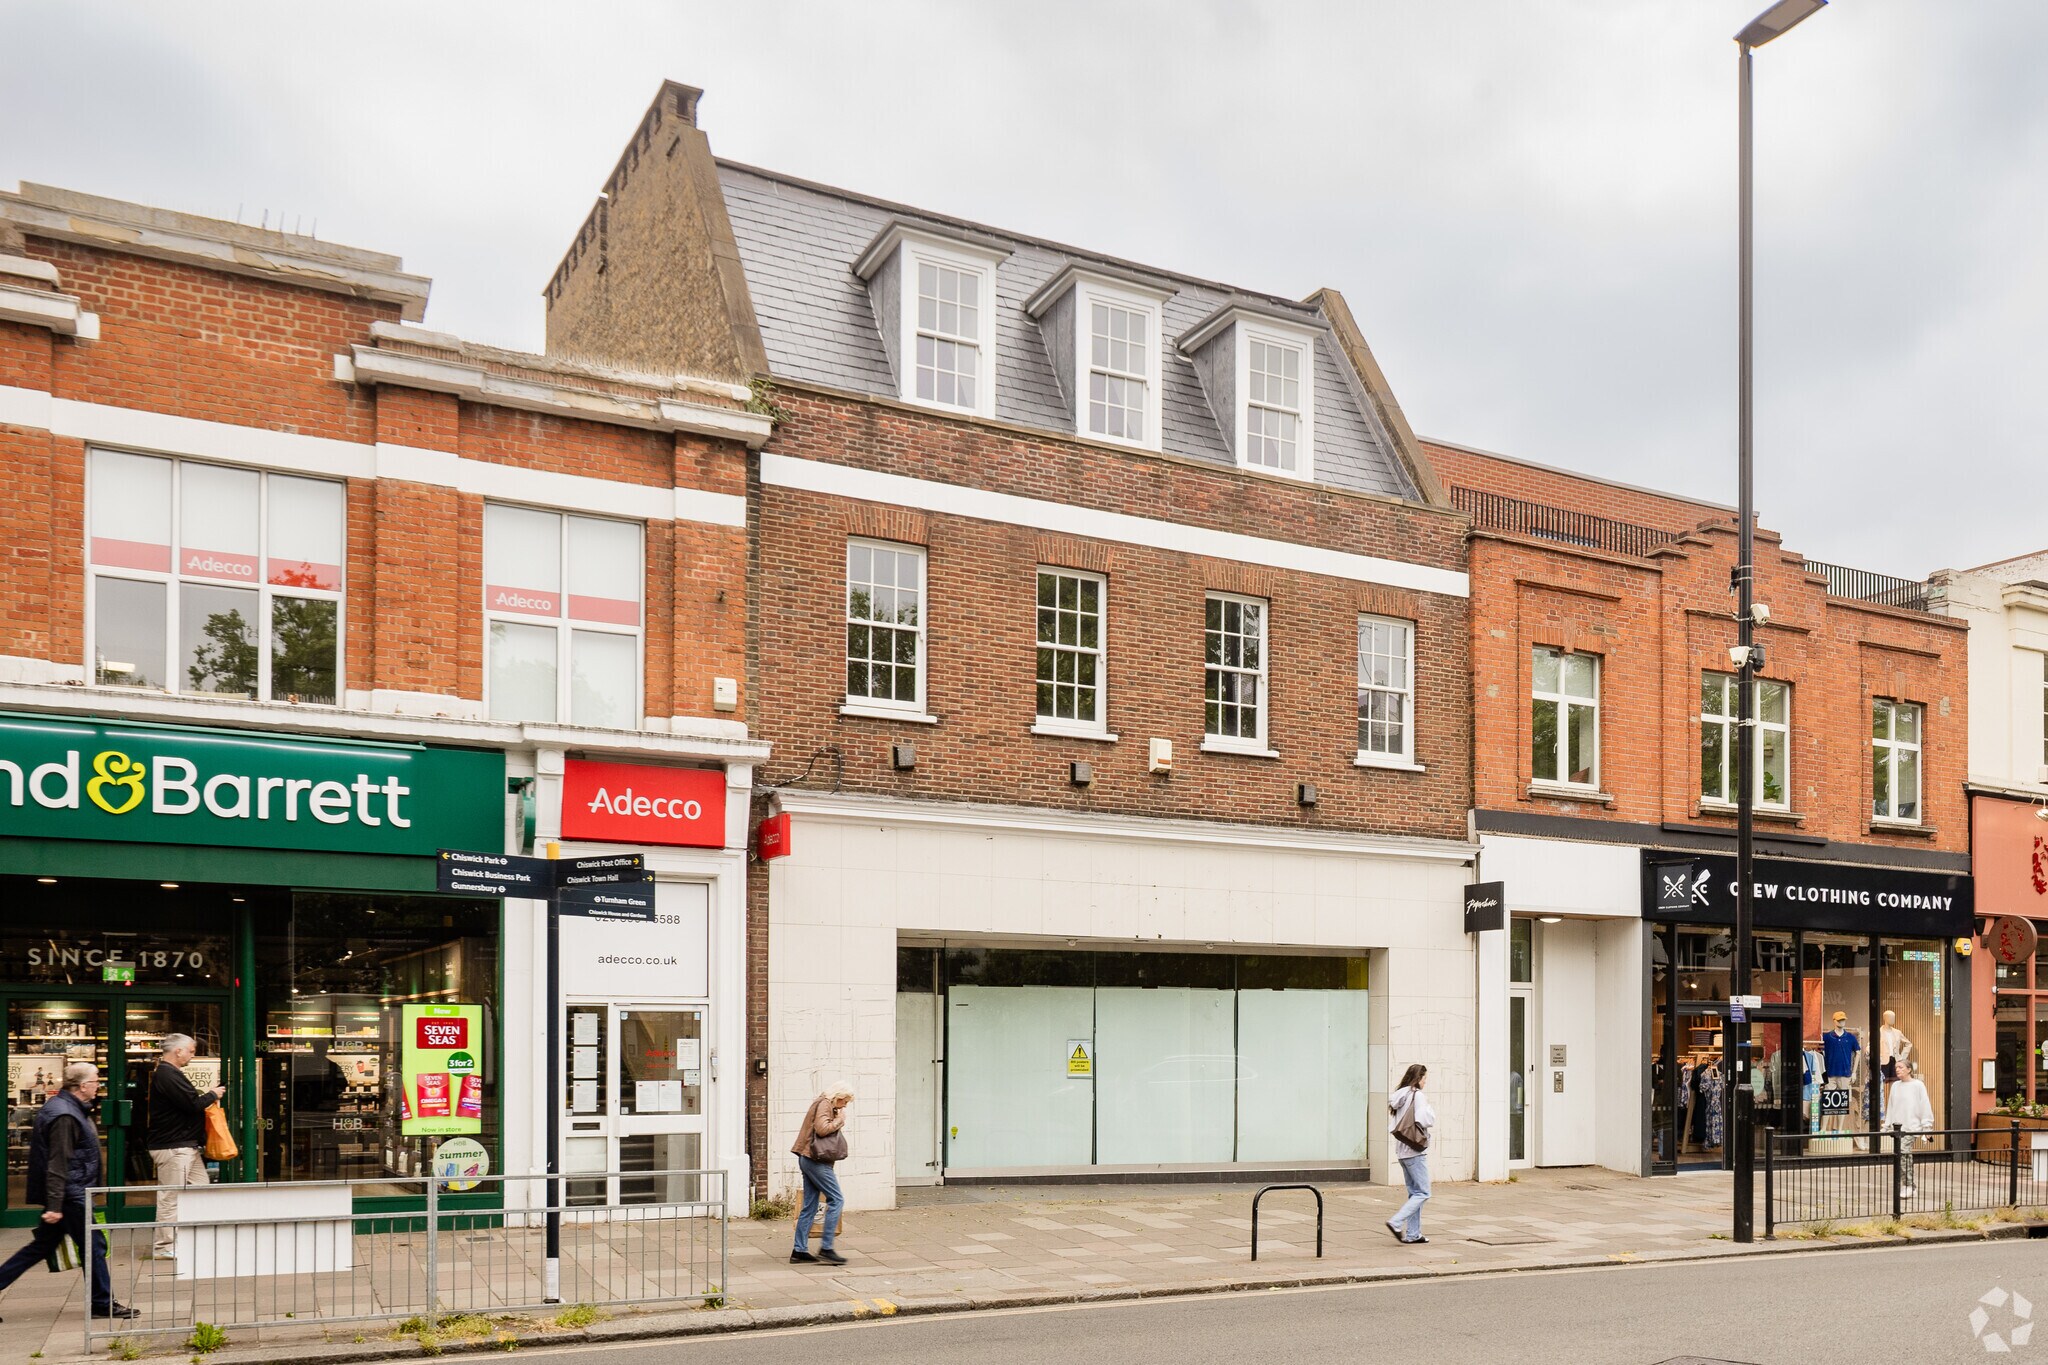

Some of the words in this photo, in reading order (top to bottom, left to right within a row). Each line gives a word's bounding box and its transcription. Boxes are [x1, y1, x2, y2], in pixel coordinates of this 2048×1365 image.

[187, 555, 252, 577] Adecco
[496, 592, 552, 611] Adecco
[588, 787, 702, 820] Adecco
[764, 831, 780, 846] Adecco
[451, 853, 483, 864] Chiswick
[483, 857, 501, 866] Park
[577, 861, 600, 870] Chiswick
[601, 859, 614, 867] Post
[614, 857, 632, 867] Office
[451, 868, 484, 879] Chiswick
[484, 871, 515, 881] Business
[515, 873, 532, 882] Park
[567, 875, 591, 884] Chiswick
[591, 874, 606, 882] Town
[606, 874, 619, 882] Hall
[451, 881, 498, 894] Gunnersbury
[601, 896, 627, 905] Turnham
[627, 898, 647, 907] Green
[1729, 882, 1779, 899] CEW
[1786, 885, 1870, 905] CLOTHING
[1877, 892, 1953, 911] COMPANY
[28, 948, 123, 967] SINCE
[140, 951, 203, 968] 1870
[597, 954, 678, 966] adecco.co.uk
[433, 1007, 452, 1015] New
[424, 1025, 461, 1035] SEVEN
[428, 1035, 456, 1045] SEAS
[332, 1118, 363, 1130] H&B
[439, 1150, 484, 1160] summer
